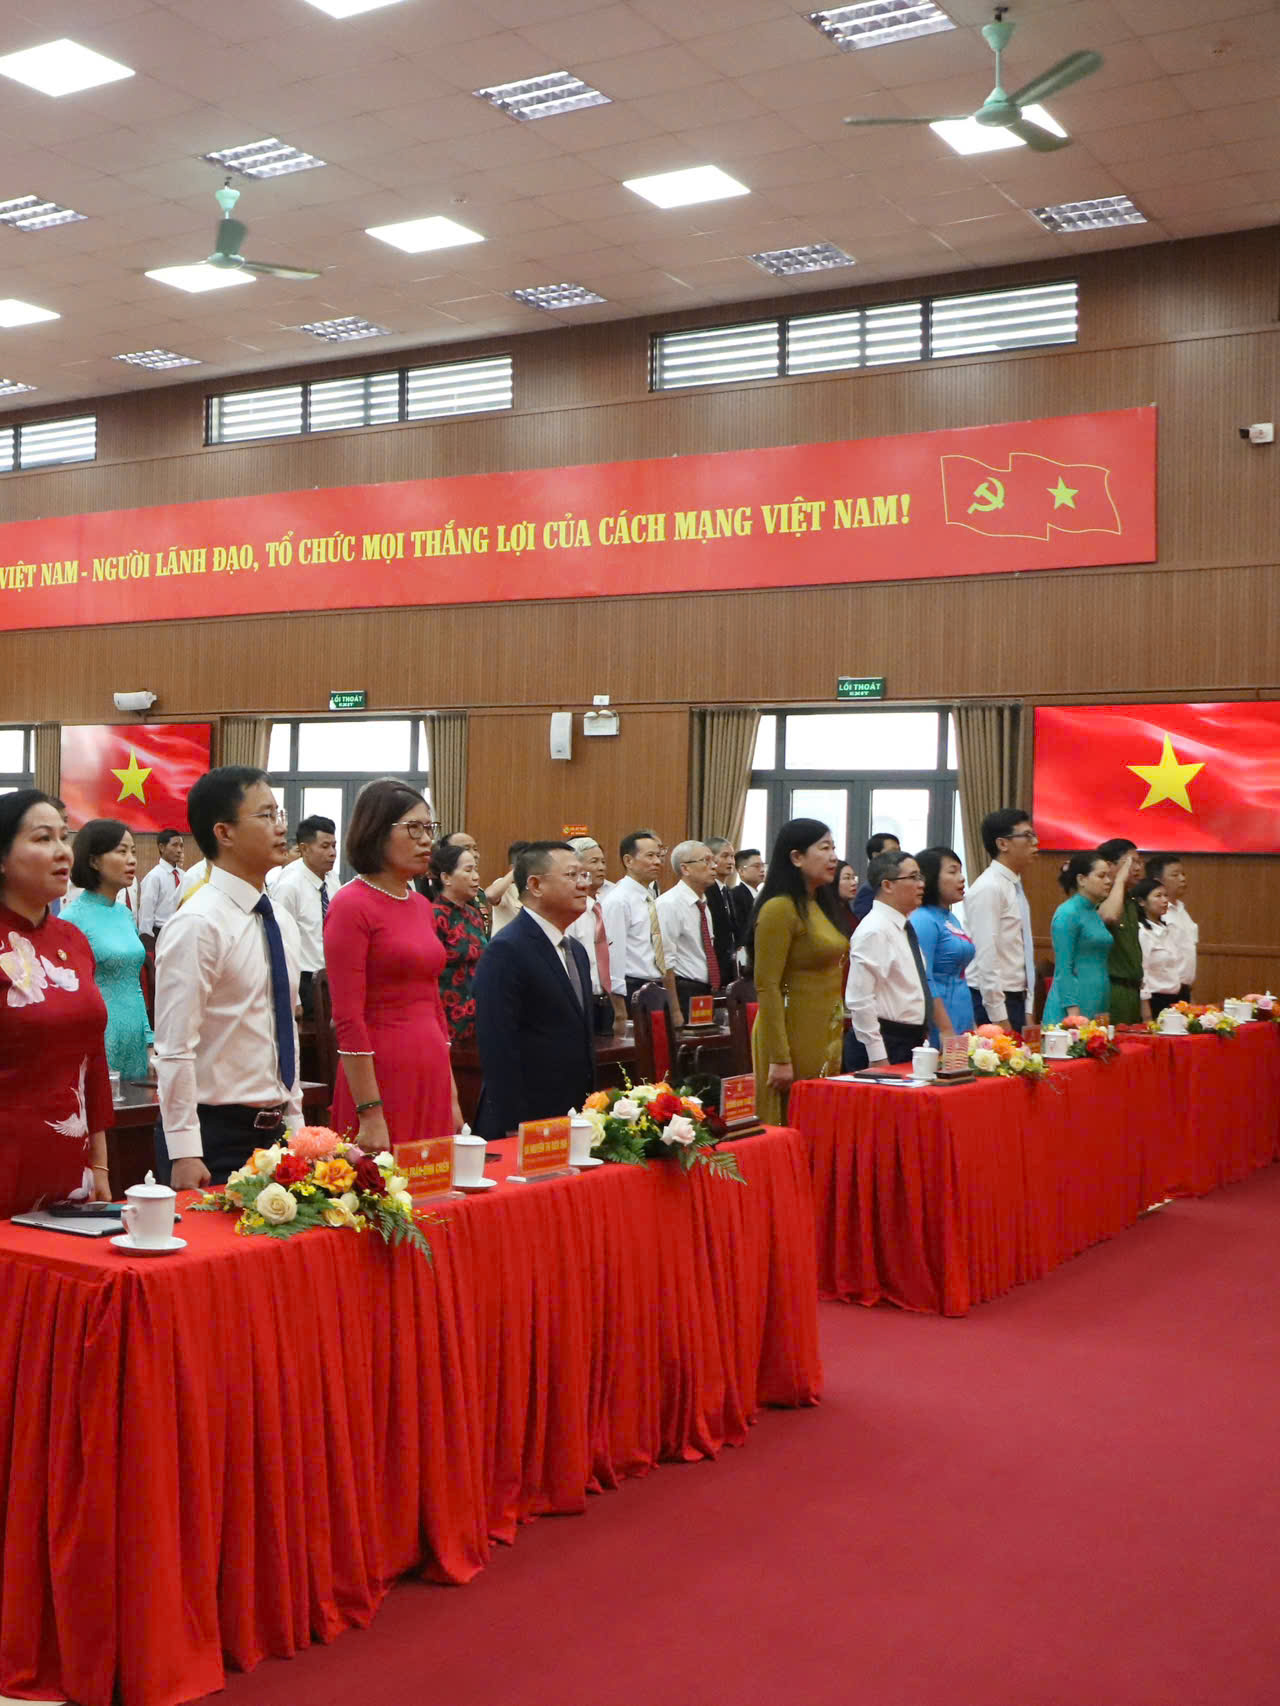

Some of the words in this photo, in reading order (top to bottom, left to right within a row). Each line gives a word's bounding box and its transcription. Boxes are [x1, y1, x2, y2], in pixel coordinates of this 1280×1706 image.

[40, 560, 79, 587] NAM
[92, 549, 151, 583] NGƯỜI
[155, 546, 208, 577] LÃNH
[212, 544, 260, 576] ĐẠO,
[265, 530, 294, 568] TỔ
[298, 531, 356, 565] CHỨC
[361, 533, 405, 565] MỌI
[411, 520, 489, 558] THẮNG
[496, 520, 537, 557] LỢI
[543, 512, 592, 550] CỦA
[598, 509, 666, 546] CÁCH
[673, 506, 753, 545] MẠNG
[760, 496, 826, 538] VIỆT
[833, 493, 910, 530] NAM!
[839, 682, 852, 691] LỐI
[853, 682, 880, 690] THOÁT
